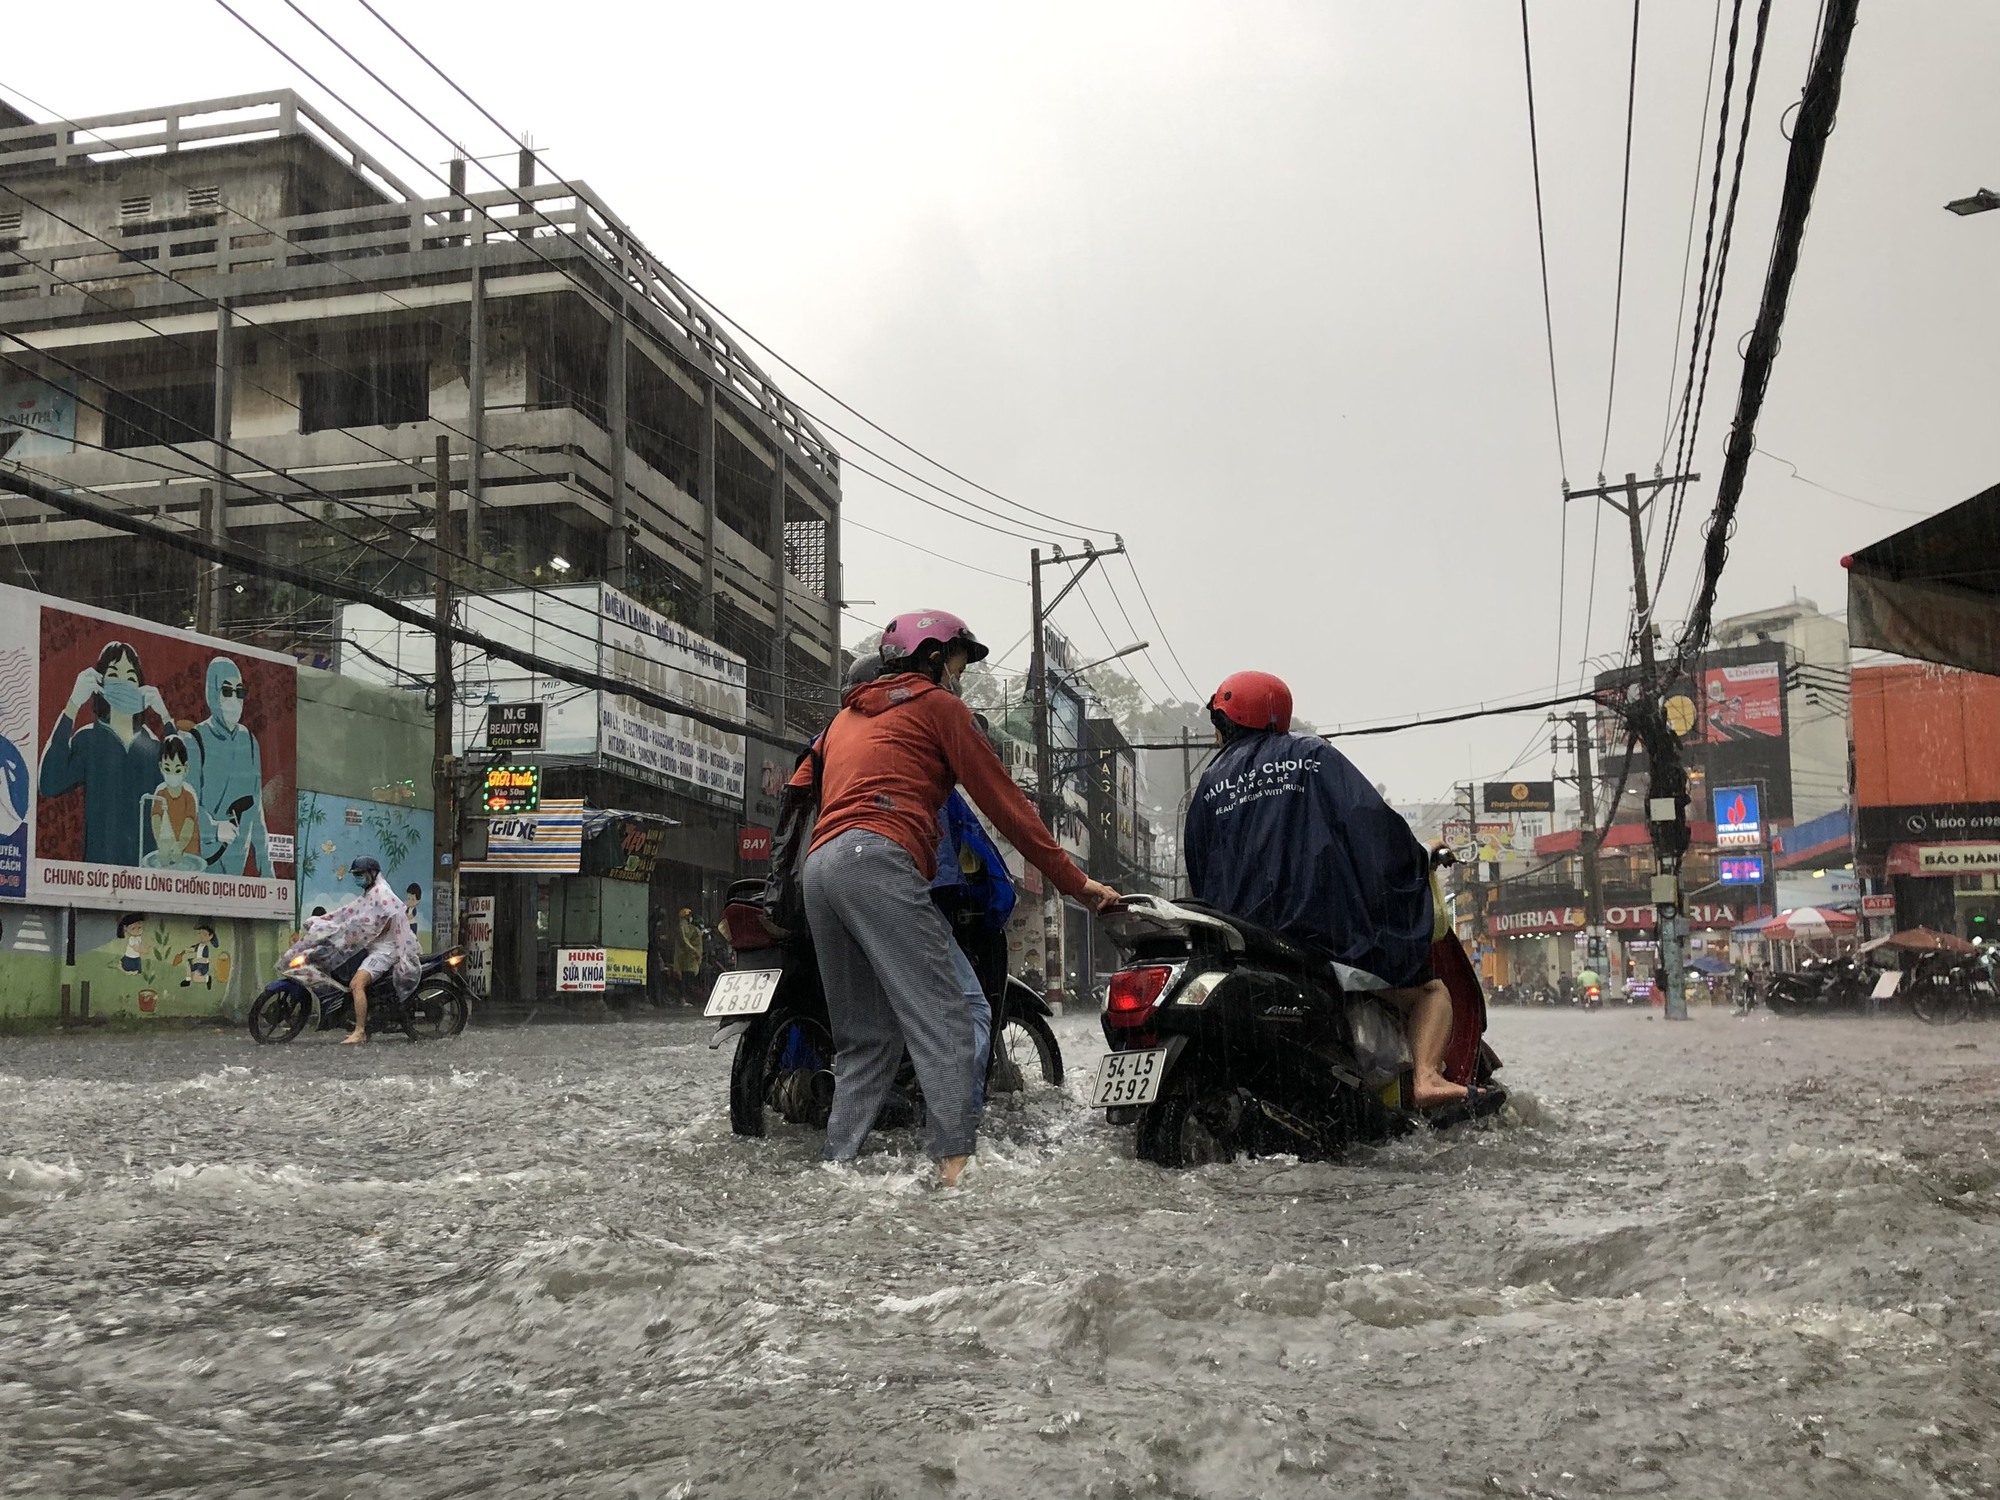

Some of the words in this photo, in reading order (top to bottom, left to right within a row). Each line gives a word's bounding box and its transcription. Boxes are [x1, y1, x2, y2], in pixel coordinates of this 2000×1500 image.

[605, 591, 626, 622] ĐIỆN
[656, 617, 675, 649] ĐIỆN
[503, 708, 526, 720] N.G
[490, 723, 521, 735] BEAUTY
[523, 722, 539, 734] SPA
[492, 737, 513, 746] 60m
[608, 734, 627, 756] HITACHI
[638, 745, 657, 767] SAMSUNG
[660, 753, 677, 774] DAEWOO
[652, 729, 675, 752] PANASONIC
[677, 739, 694, 759] TOSHIBA
[710, 751, 730, 772] MITSUBISHI
[1262, 759, 1321, 774] CHOICE
[511, 771, 533, 786] Nails
[510, 788, 525, 796] 50m
[1240, 790, 1262, 804] BEGINS
[1935, 816, 1966, 829] 1800
[517, 821, 536, 841] XE
[743, 838, 766, 849] BAY
[1720, 834, 1755, 845] PVOIL
[1925, 851, 1959, 865] BẢO
[44, 868, 84, 886] CHUNG
[87, 869, 109, 888] SỨC
[112, 869, 142, 890] ĐỒNG
[145, 873, 172, 893] LÒNG
[175, 876, 210, 896] CHỐNG
[213, 882, 235, 899] DỊCH
[238, 884, 266, 899] COVID
[276, 887, 288, 900] 19
[1867, 899, 1890, 908] ATM
[1497, 907, 1559, 931] LOTTERIA
[467, 919, 490, 942] HÙNG
[568, 949, 604, 961] HÙNG
[563, 962, 580, 981] SỬA
[582, 962, 605, 981] KHÓA
[723, 973, 770, 993] 54-X3
[716, 993, 763, 1012] 4830
[1107, 1053, 1156, 1078] 54-L5
[1101, 1078, 1150, 1103] 2592
